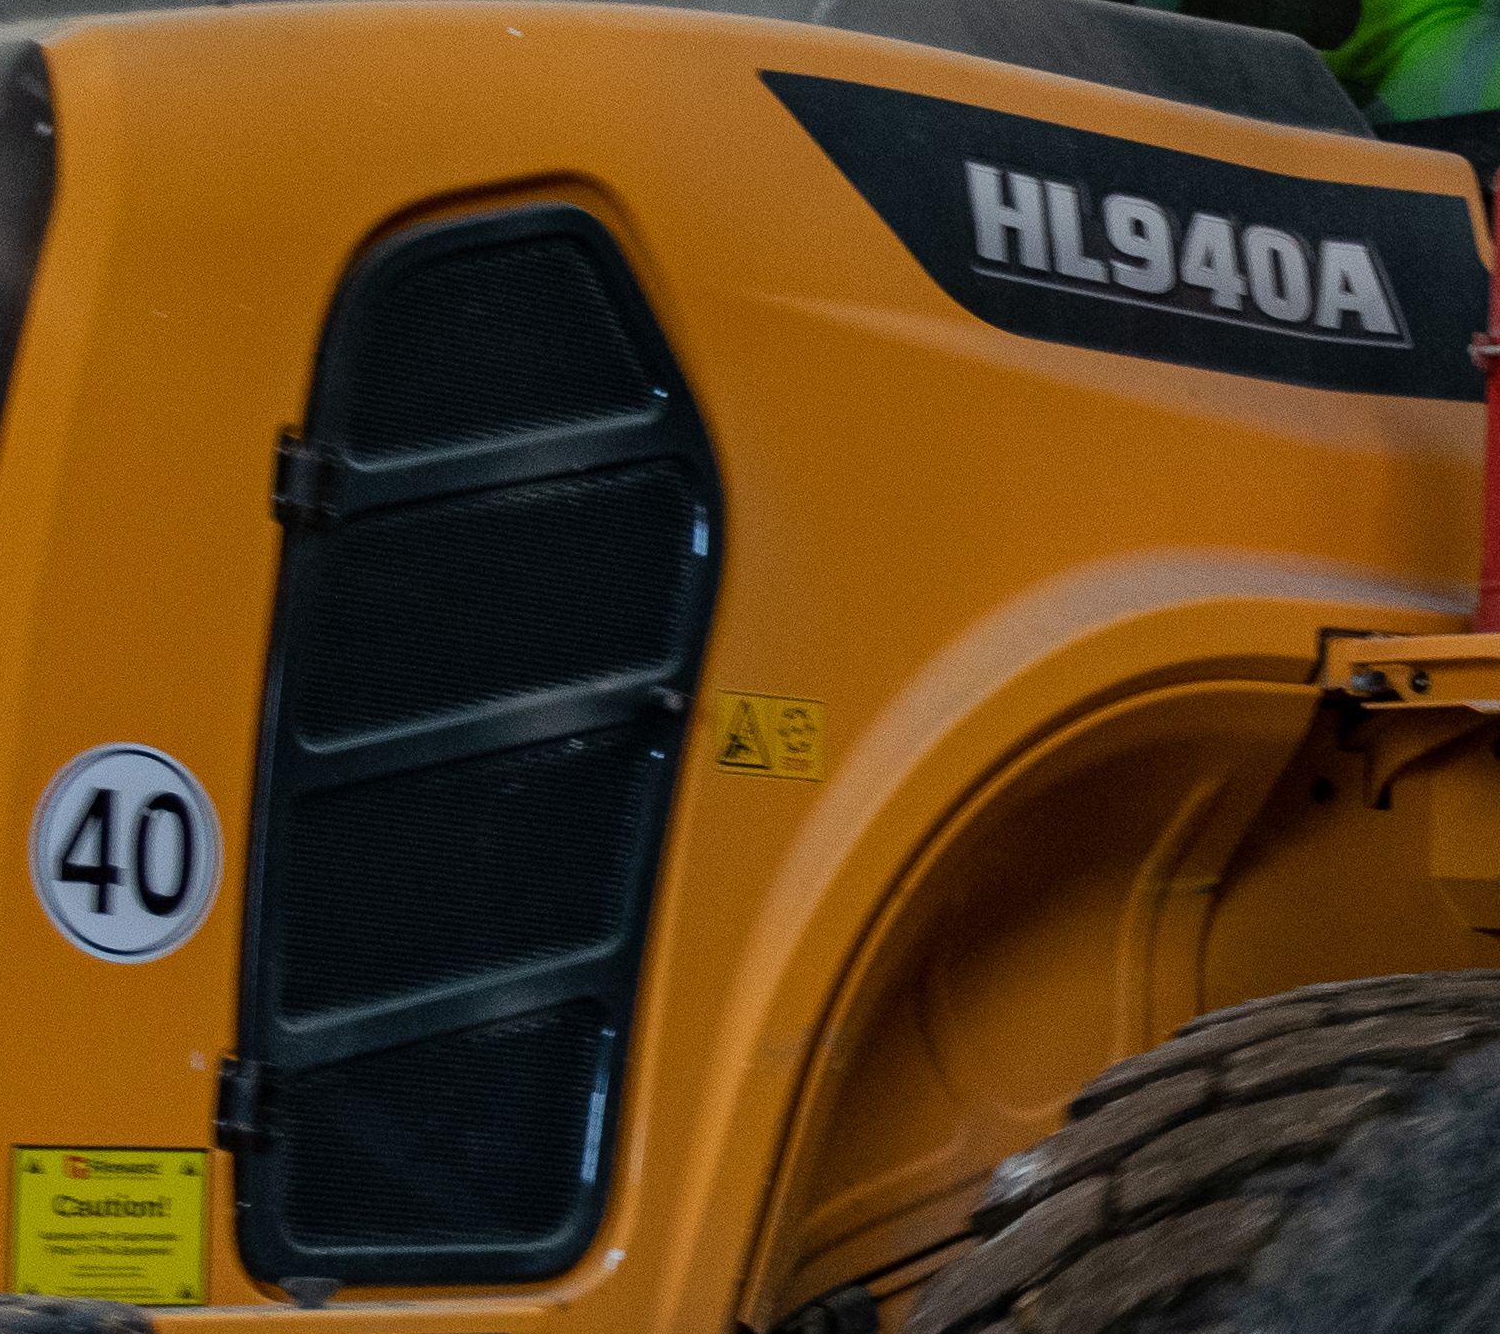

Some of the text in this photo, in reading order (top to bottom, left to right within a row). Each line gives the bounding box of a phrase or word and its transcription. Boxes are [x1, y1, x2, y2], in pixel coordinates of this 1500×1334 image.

[963, 163, 1400, 334] HL940A
[57, 787, 194, 917] 40
[53, 1192, 173, 1218] Caution!
